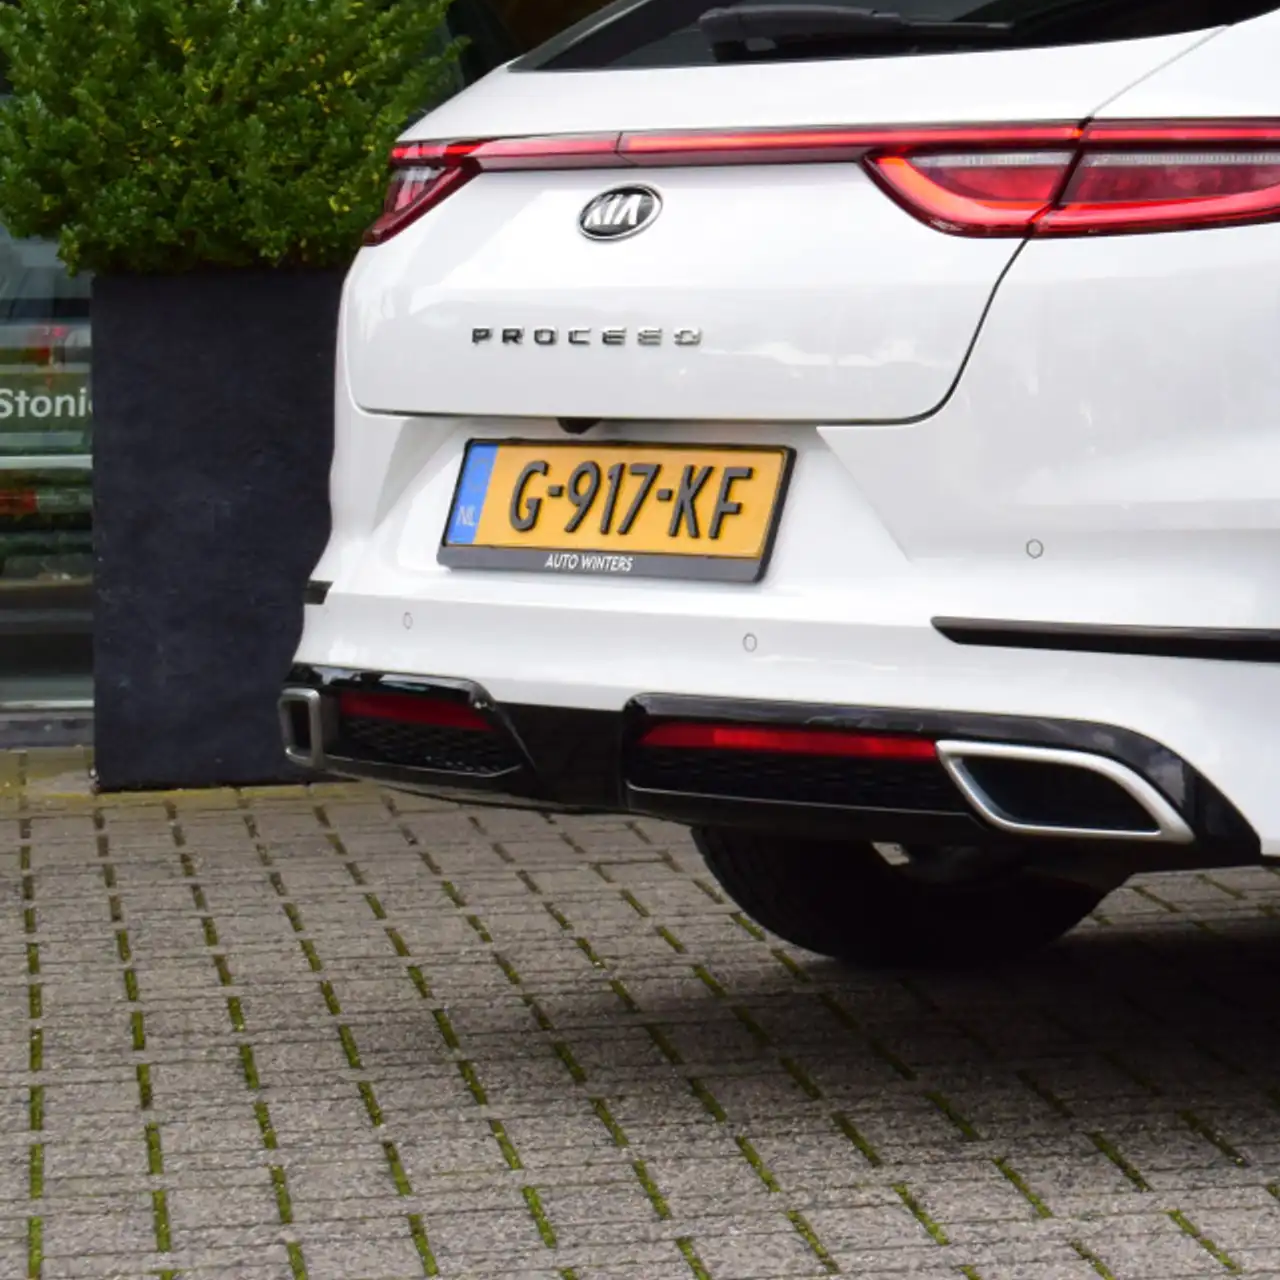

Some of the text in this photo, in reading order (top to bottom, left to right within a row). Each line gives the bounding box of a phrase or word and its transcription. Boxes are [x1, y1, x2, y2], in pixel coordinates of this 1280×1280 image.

[471, 326, 703, 347] PROCEED
[0, 387, 93, 419] Stoni
[508, 459, 754, 540] G-917-KF
[455, 504, 477, 527] NL
[544, 553, 634, 572] AUTO WINTERS
